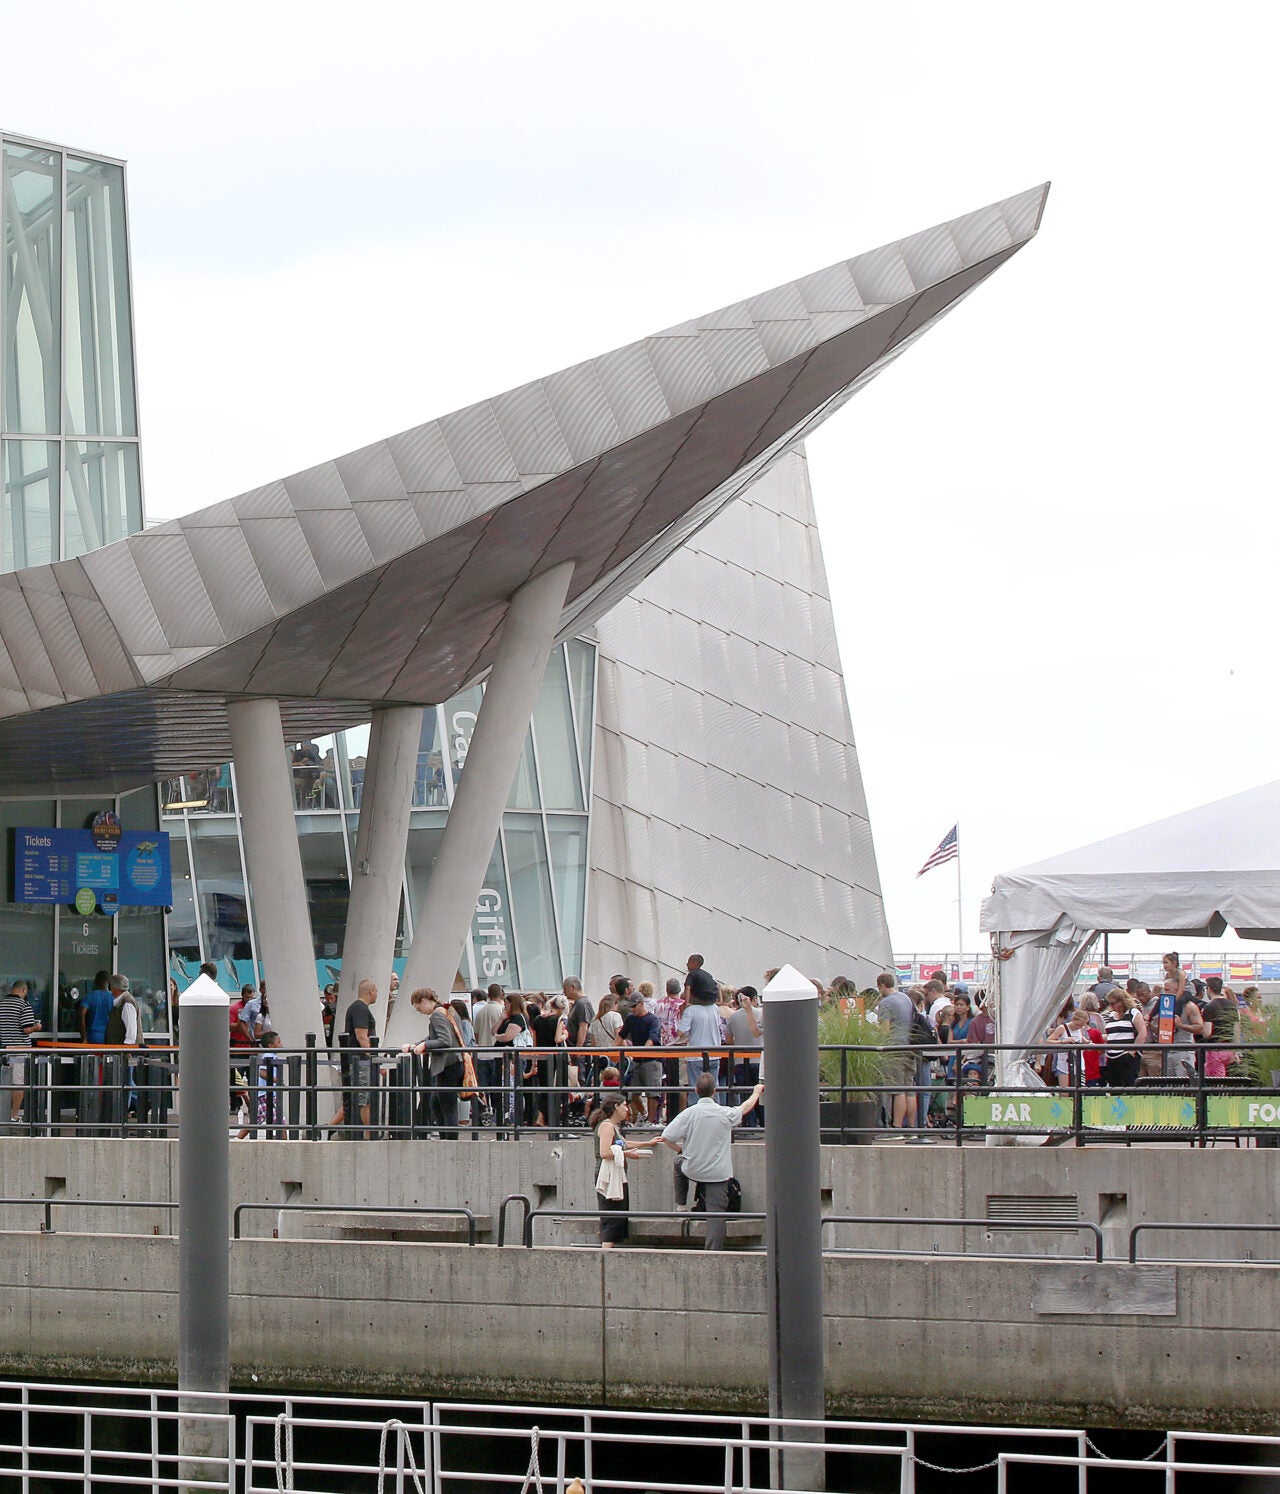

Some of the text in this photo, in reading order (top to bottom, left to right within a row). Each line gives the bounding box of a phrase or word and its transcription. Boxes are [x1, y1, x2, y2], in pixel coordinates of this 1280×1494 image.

[24, 835, 51, 847] Tickets
[82, 922, 89, 937] 6
[475, 888, 507, 977] Gifts
[72, 942, 99, 955] Tickets
[991, 1103, 1032, 1122] BAR
[1248, 1103, 1280, 1122] FO
